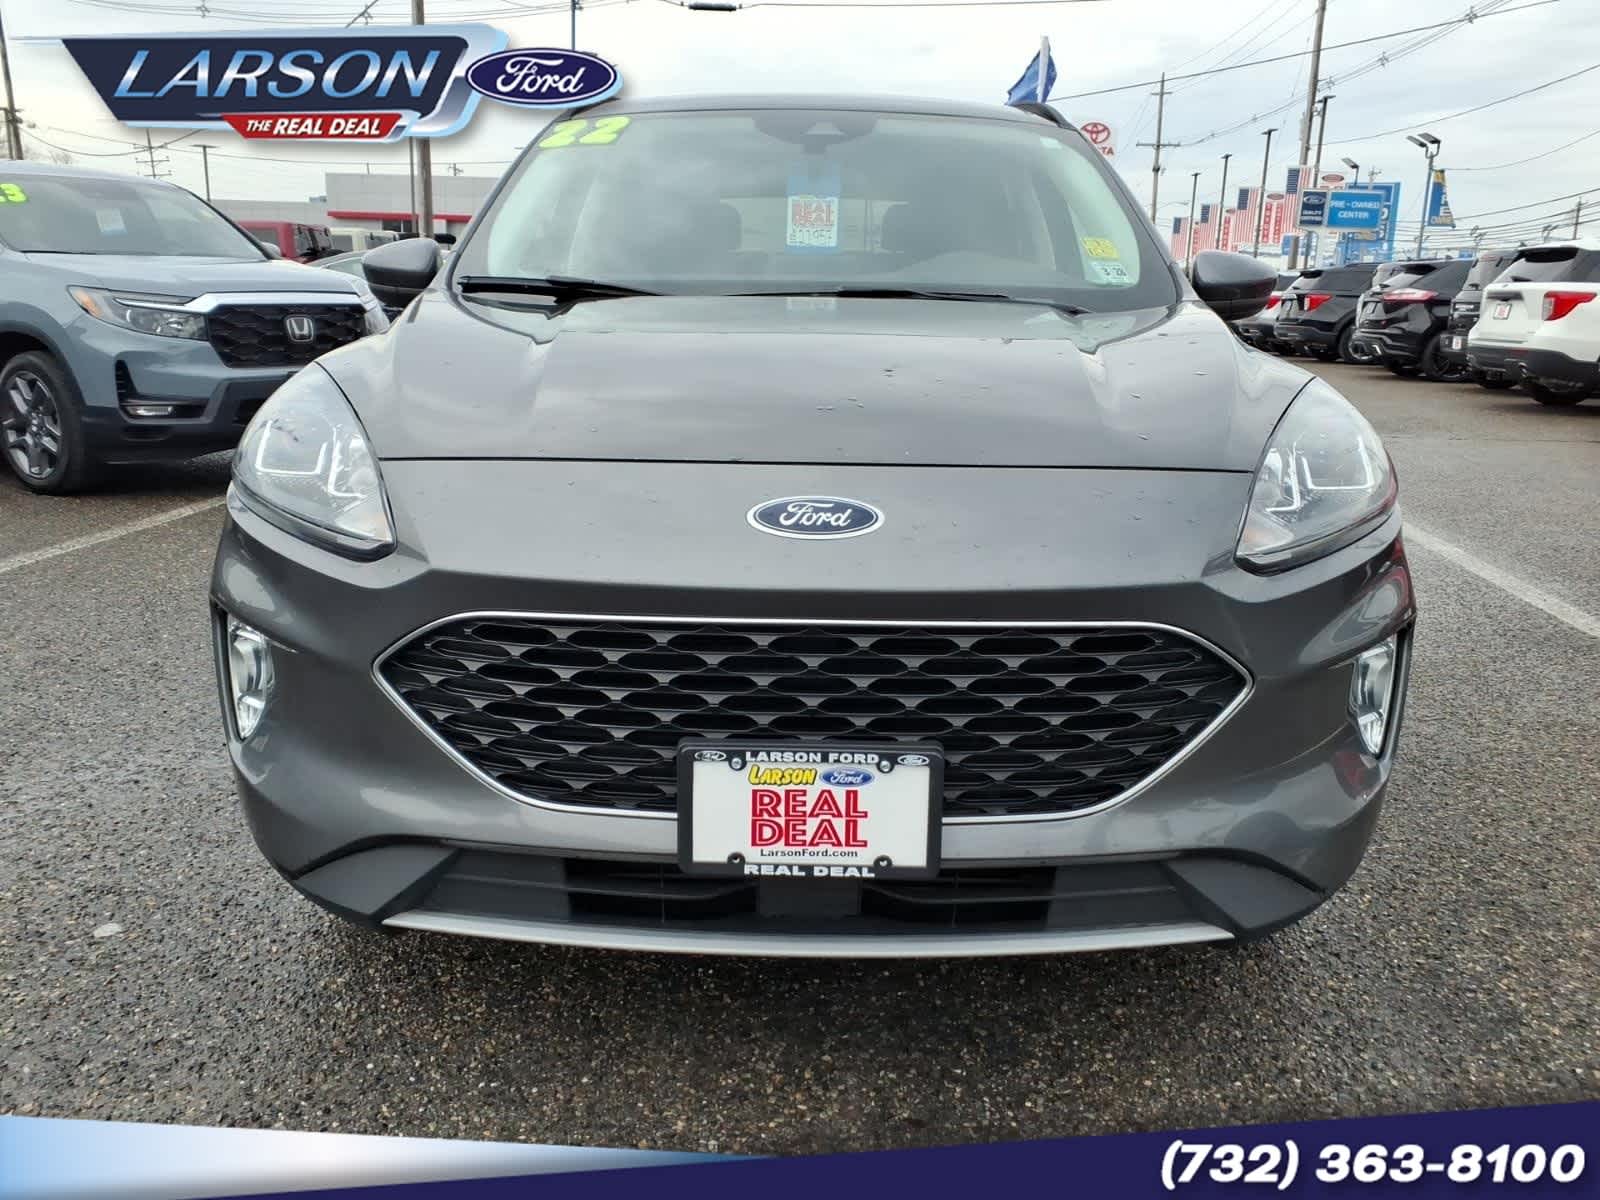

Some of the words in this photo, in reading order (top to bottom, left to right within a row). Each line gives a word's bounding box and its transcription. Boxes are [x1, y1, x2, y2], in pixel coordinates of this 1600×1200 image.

[538, 115, 631, 149] 22
[1337, 210, 1369, 219] CENTER
[779, 501, 852, 527] Ford
[745, 751, 821, 763] LARSON
[828, 752, 879, 764] FORD
[830, 768, 864, 784] Ford
[751, 789, 869, 819] REAL
[751, 819, 868, 848] DEAL
[760, 848, 859, 857] LarsonFord.com
[744, 864, 806, 876] REAL
[813, 866, 876, 878] DEAL
